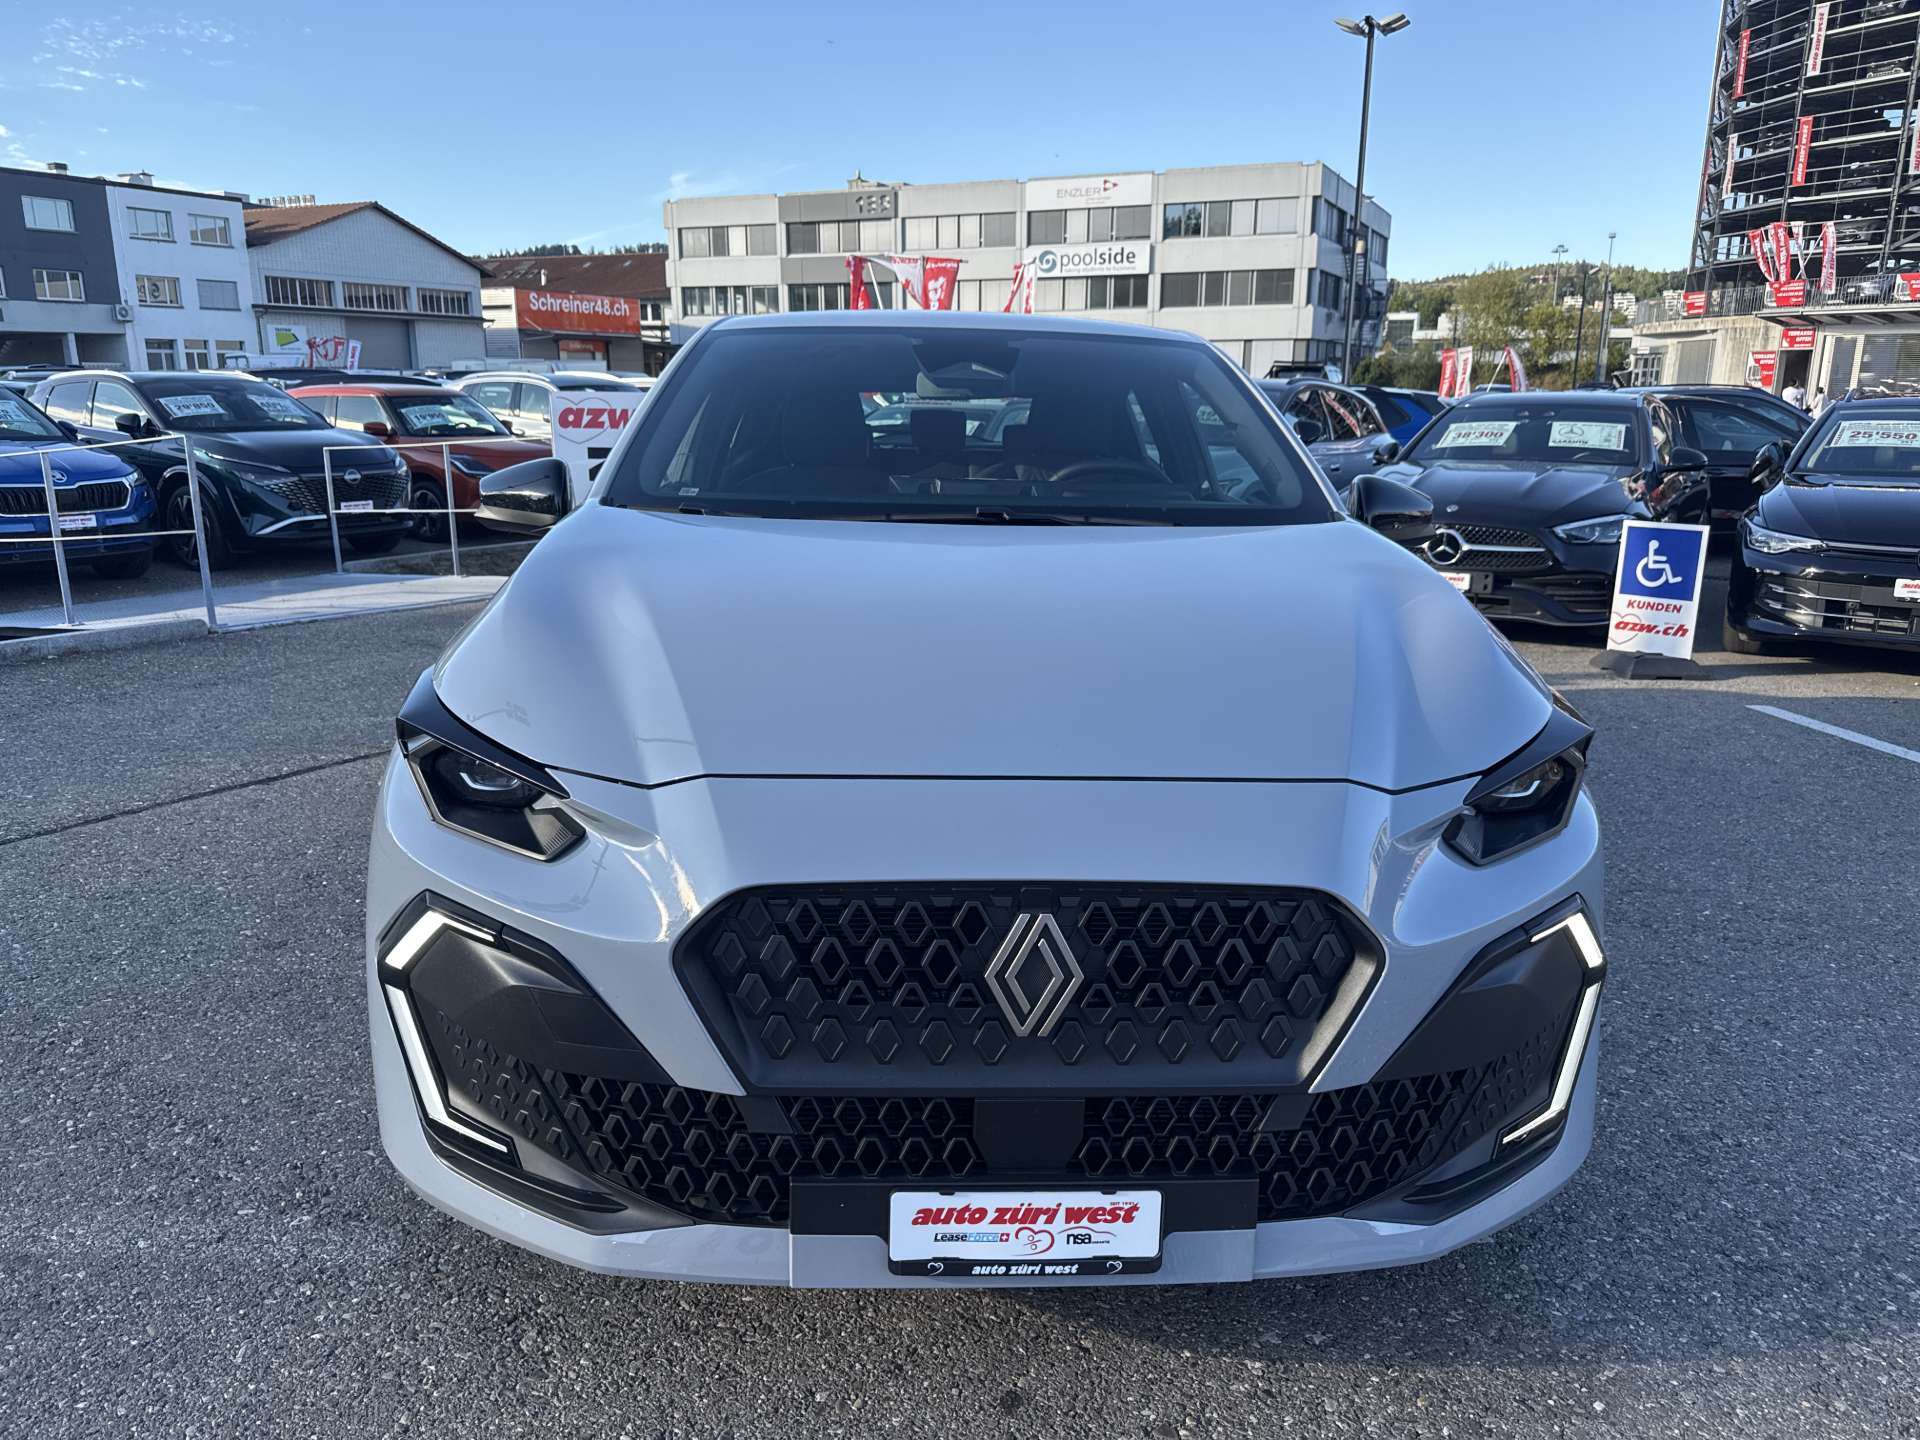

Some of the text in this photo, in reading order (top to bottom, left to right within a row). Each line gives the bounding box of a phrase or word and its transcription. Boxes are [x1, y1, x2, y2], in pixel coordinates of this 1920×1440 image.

[1056, 187, 1101, 198] ENZLER
[1060, 246, 1136, 273] poolside
[529, 291, 630, 316] Schreiner48.ch
[1850, 431, 1917, 440] 25'550
[1627, 599, 1683, 614] KUNDEN
[1614, 621, 1690, 638] azw.ch
[911, 1202, 1140, 1226] auto züri west
[934, 1233, 999, 1243] LeaseForce
[1066, 1233, 1092, 1245] nsa
[971, 1263, 1079, 1275] auto züri west
